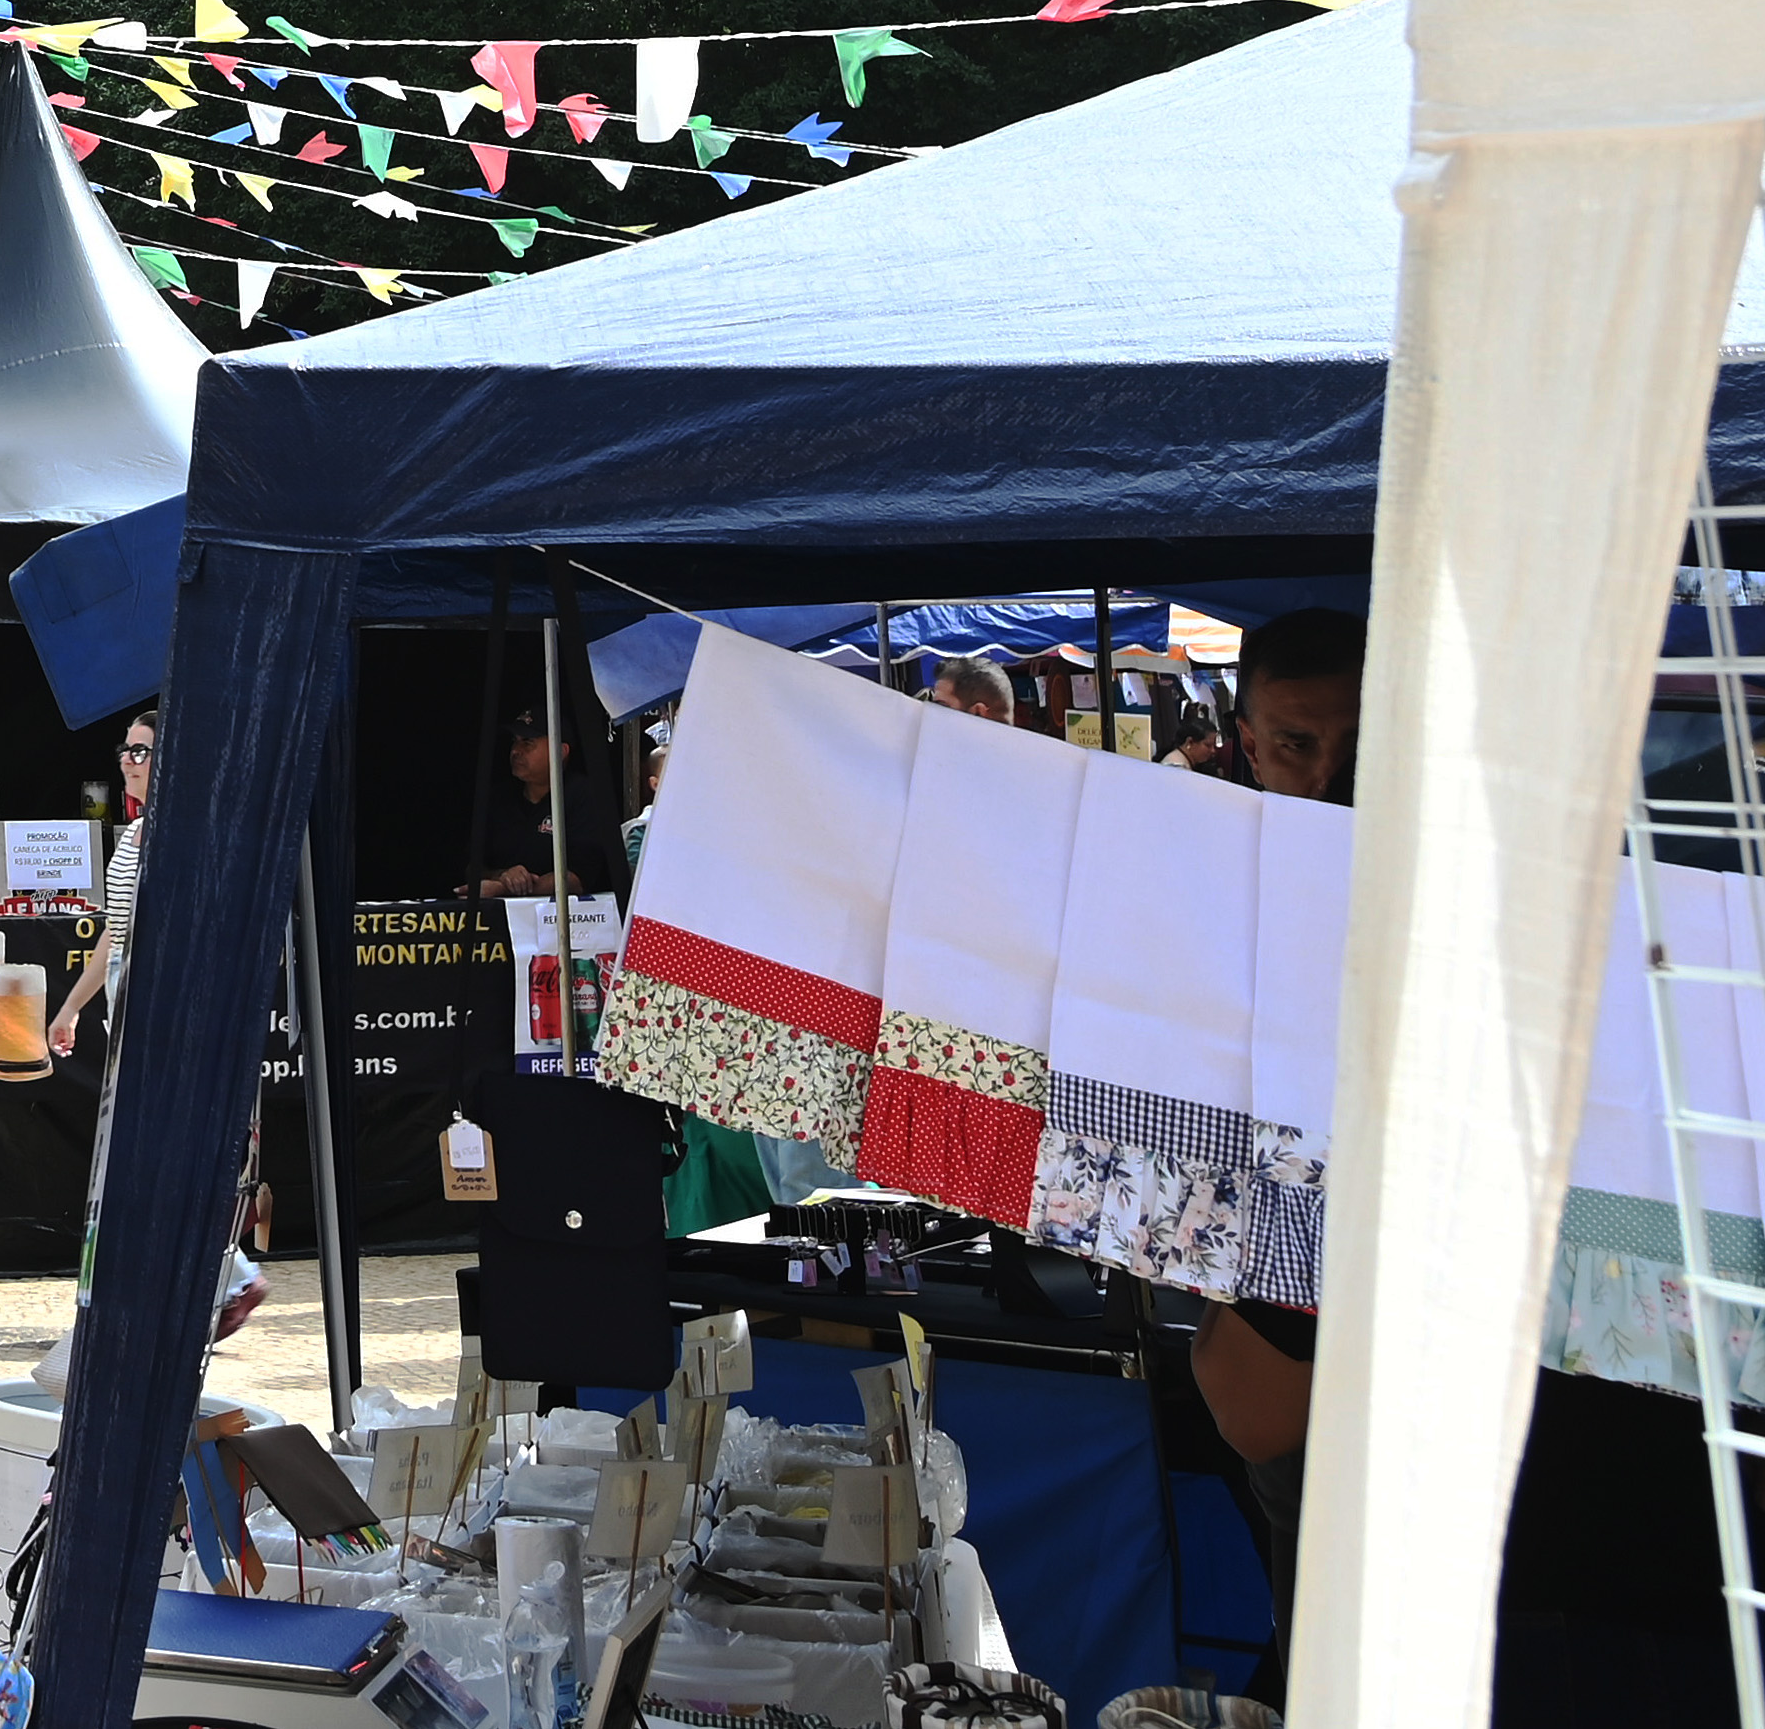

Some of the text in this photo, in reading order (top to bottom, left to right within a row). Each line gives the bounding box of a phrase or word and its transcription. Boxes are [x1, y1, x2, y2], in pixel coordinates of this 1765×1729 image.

[27, 831, 68, 841] PROMOÇÃO
[73, 857, 83, 865] DE
[7, 904, 27, 913] LE
[356, 941, 507, 967] MONTANHA
